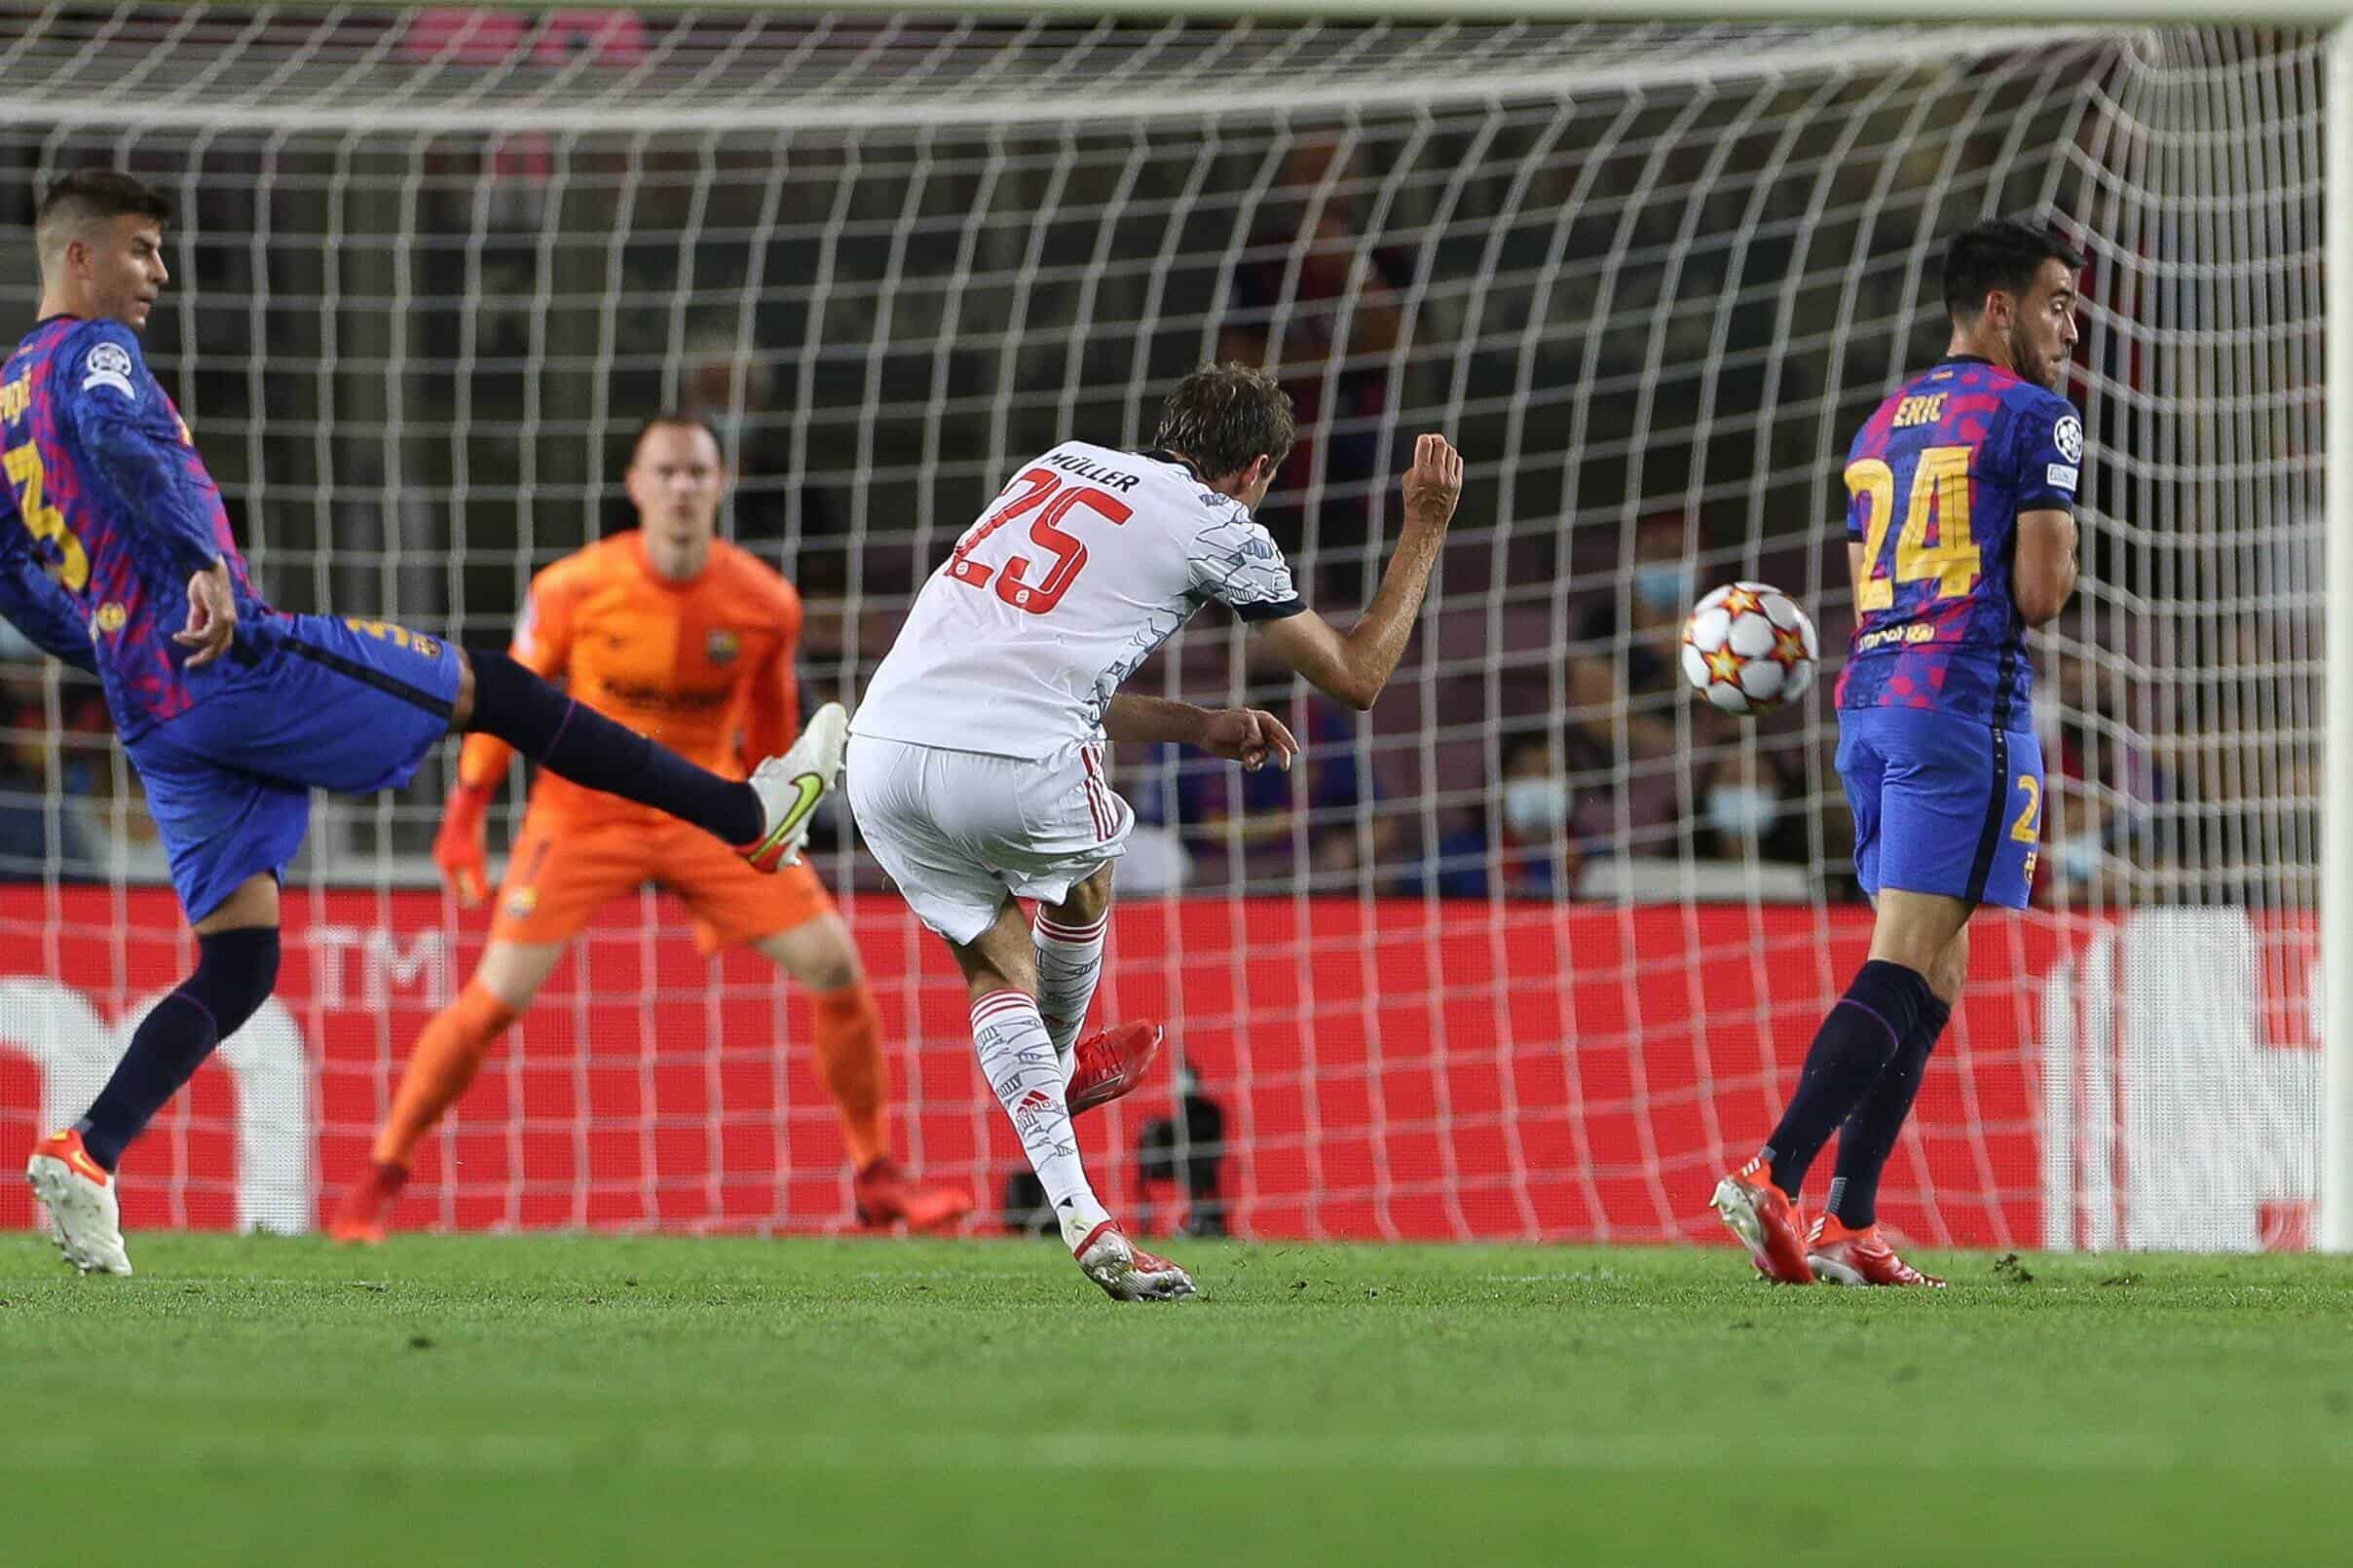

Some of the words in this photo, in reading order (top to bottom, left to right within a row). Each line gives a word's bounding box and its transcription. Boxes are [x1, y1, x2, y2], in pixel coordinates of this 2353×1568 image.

[1892, 392, 1949, 428] ERIC
[1042, 452, 1140, 494] MÜLLER
[943, 467, 1135, 616] 25
[1844, 446, 1981, 613] 24
[304, 925, 445, 1013] TM
